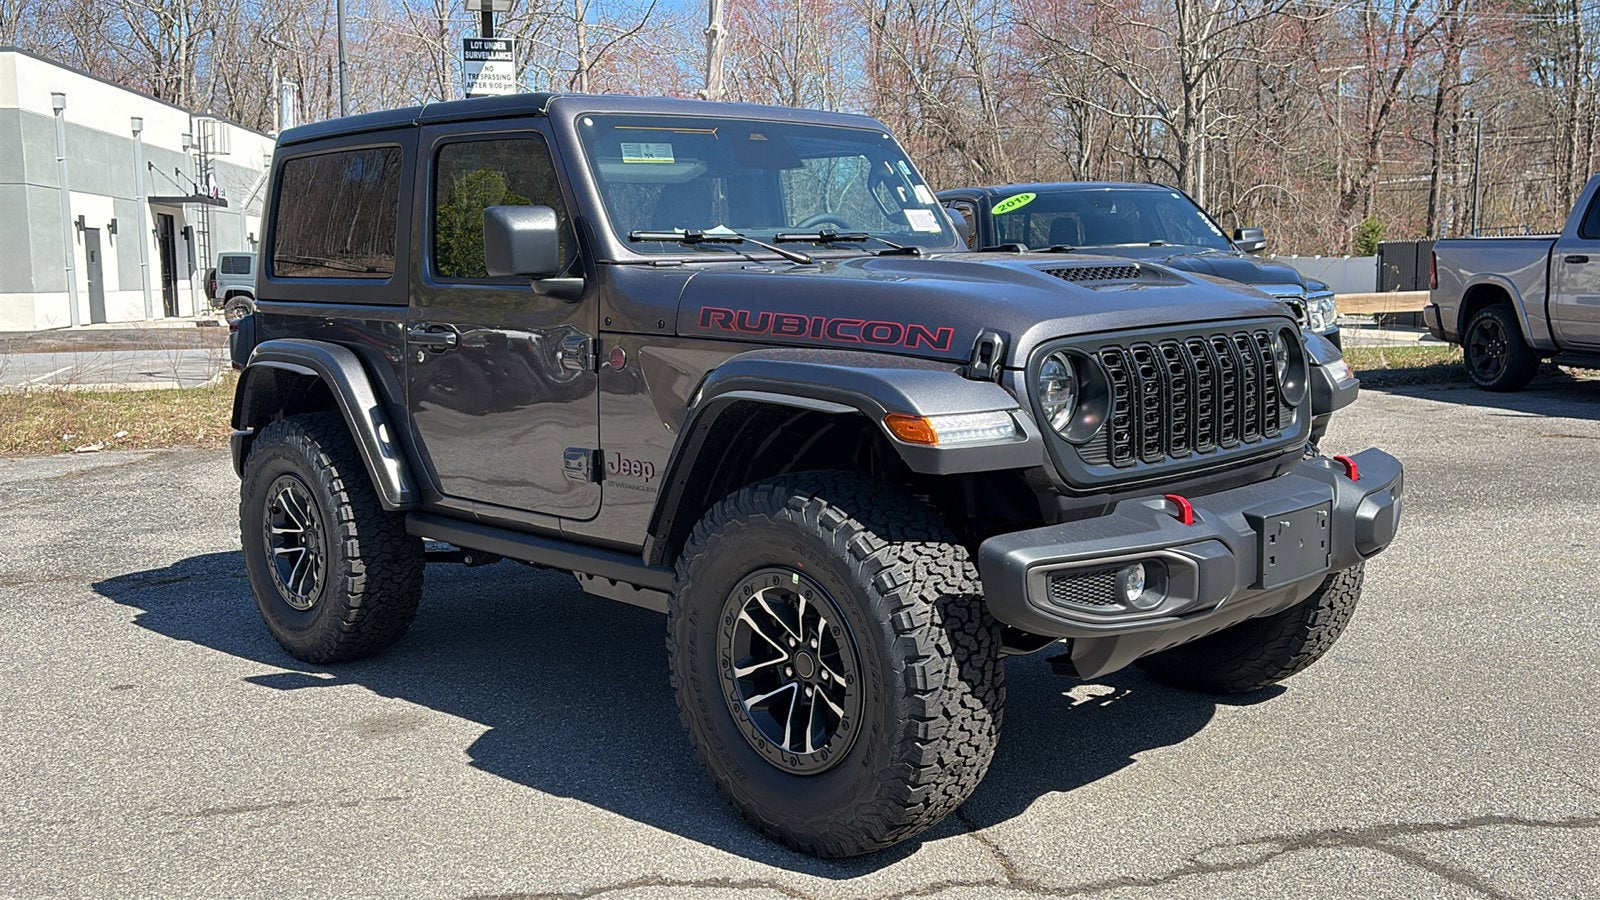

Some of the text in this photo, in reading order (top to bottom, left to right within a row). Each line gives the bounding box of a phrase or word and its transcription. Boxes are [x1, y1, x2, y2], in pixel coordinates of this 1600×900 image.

[470, 41, 507, 50] LOT UNDER
[464, 50, 513, 60] SURVEILLANCE
[468, 72, 512, 81] TRESPASSING
[466, 81, 487, 89] AFTER
[998, 194, 1030, 212] 2019
[699, 306, 955, 351] RUBICON
[608, 452, 655, 482] Jeep
